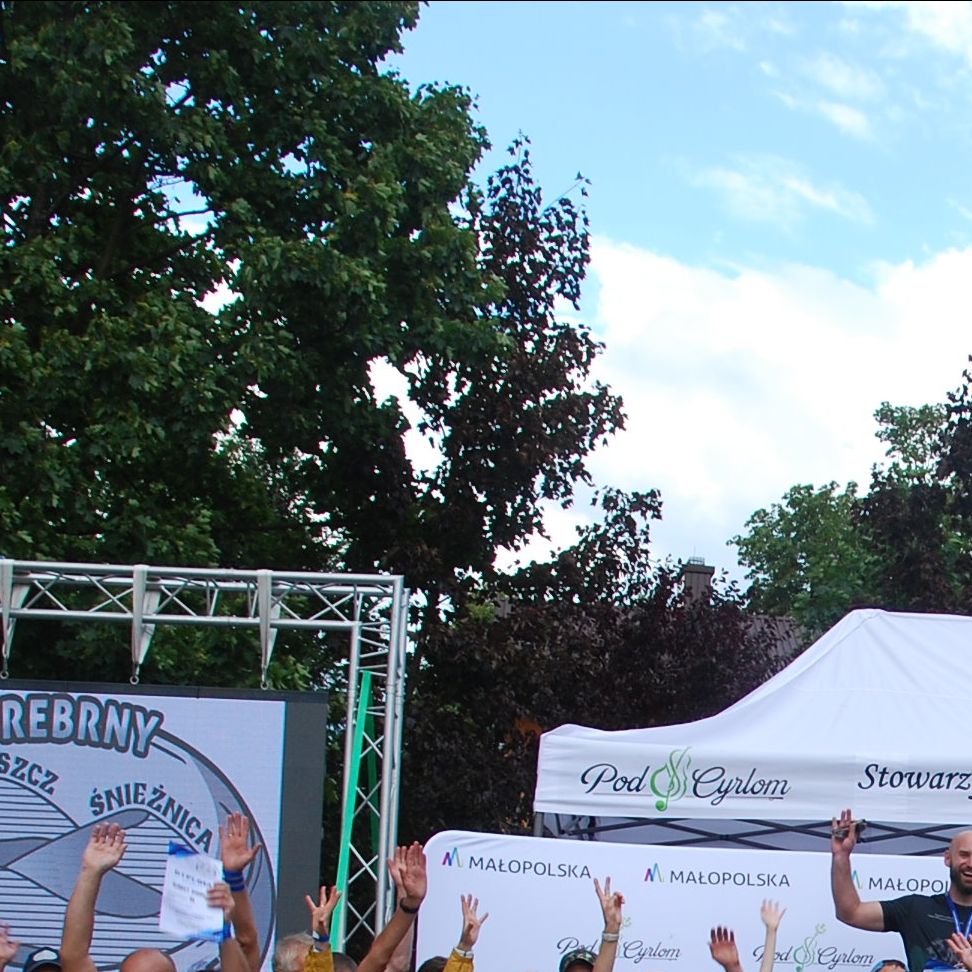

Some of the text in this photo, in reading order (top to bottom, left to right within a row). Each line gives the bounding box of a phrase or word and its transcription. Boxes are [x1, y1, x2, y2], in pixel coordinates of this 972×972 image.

[581, 763, 791, 805] Pod Cyrlom
[90, 782, 213, 854] ŚNIEŻNICA
[469, 856, 592, 879] MAŁOPOLSKA
[670, 870, 790, 888] MAŁOPOLSKA
[623, 940, 682, 963] Cyrlom
[817, 946, 875, 970] Cyrlom
